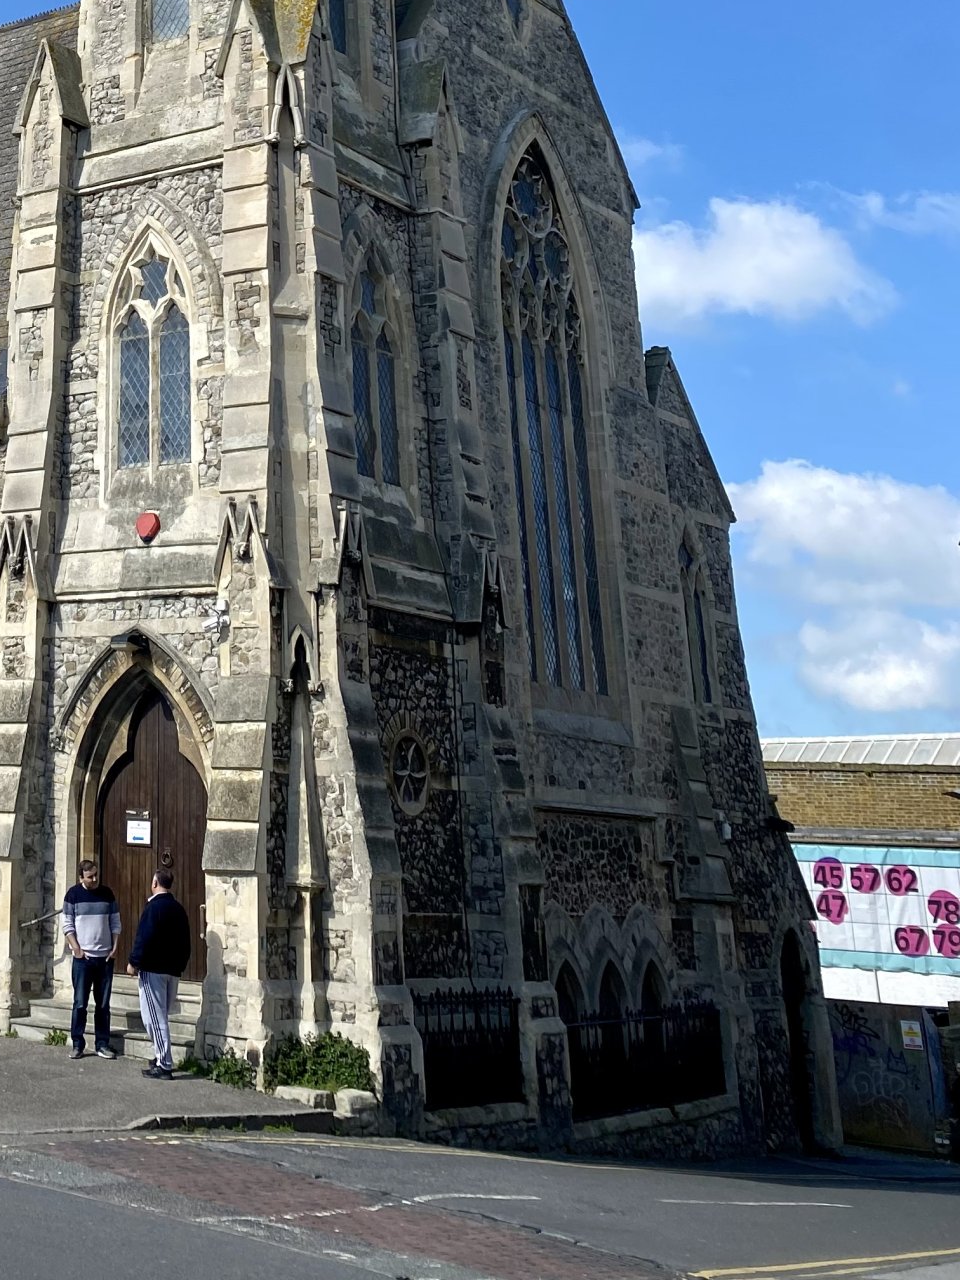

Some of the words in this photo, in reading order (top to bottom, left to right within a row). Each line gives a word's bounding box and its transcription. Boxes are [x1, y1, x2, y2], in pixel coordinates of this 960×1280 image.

[814, 865, 843, 889] 45
[850, 867, 879, 892] 57
[887, 868, 919, 893] 62
[817, 894, 846, 918] 47
[928, 899, 960, 925] 78
[894, 927, 925, 953] 67
[932, 929, 960, 956] 79
